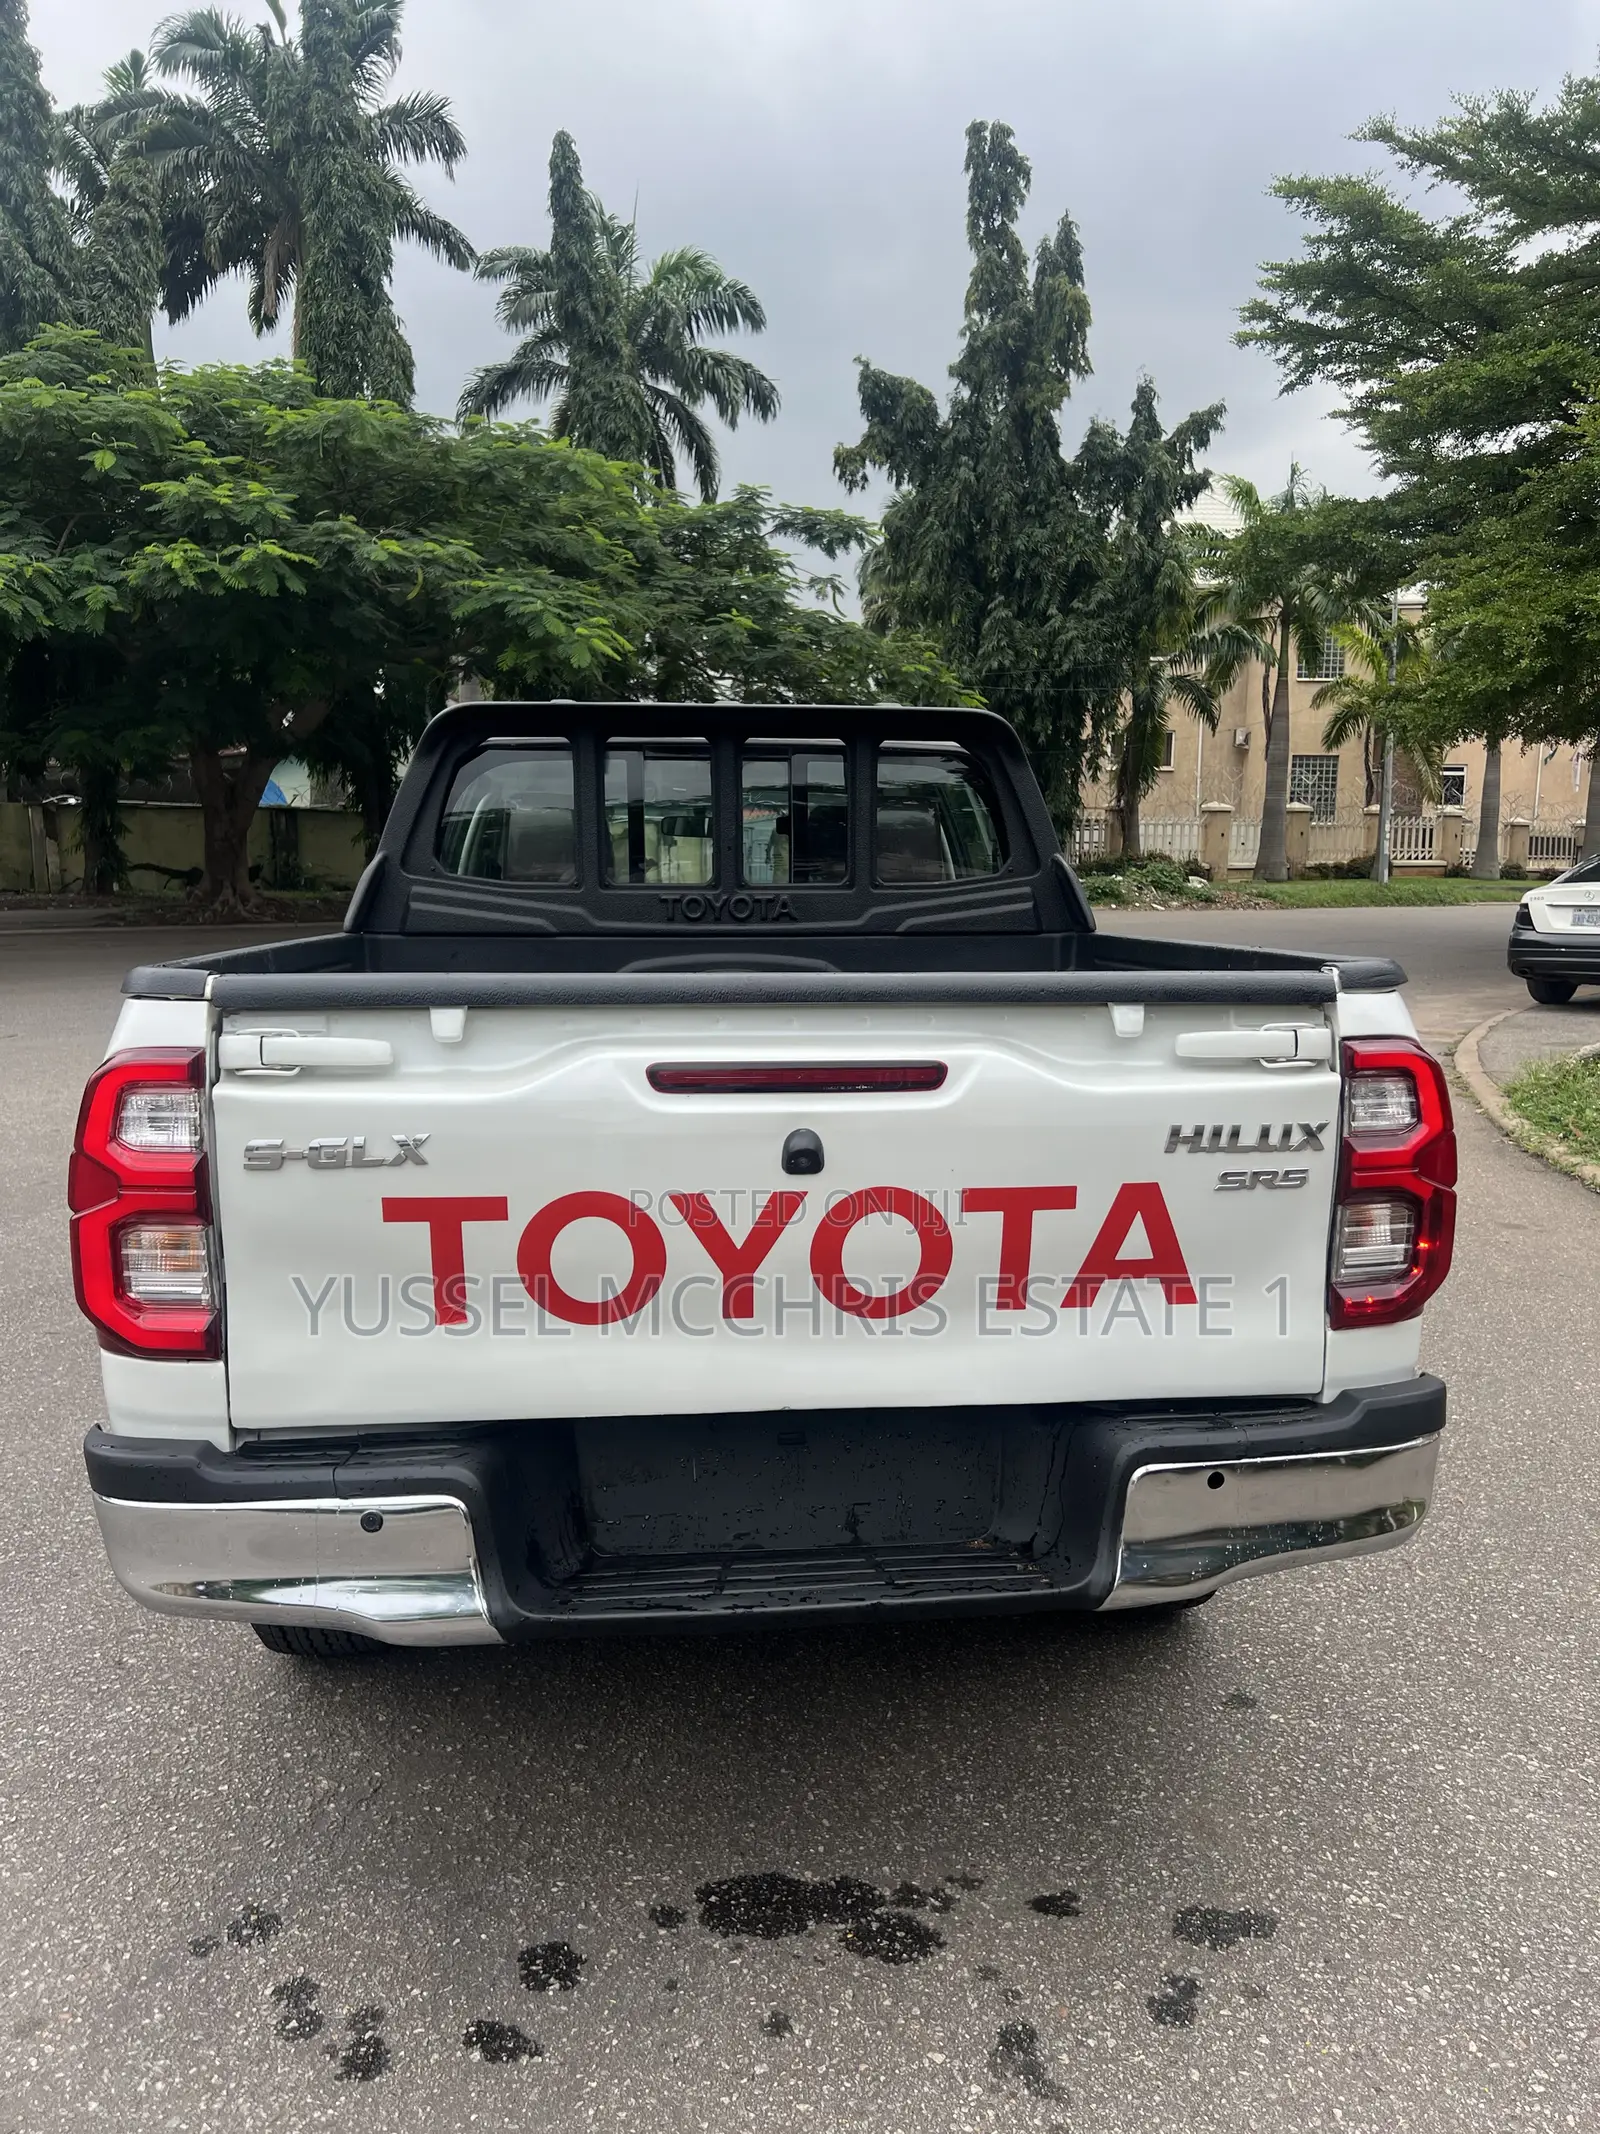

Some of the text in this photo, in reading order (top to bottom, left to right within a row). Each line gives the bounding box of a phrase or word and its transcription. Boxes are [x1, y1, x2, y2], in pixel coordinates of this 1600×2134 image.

[660, 893, 797, 921] TOYOTA
[243, 1133, 431, 1171] S-GLX
[1164, 1120, 1330, 1154] HILUX
[1214, 1168, 1308, 1191] SR5
[381, 1182, 1199, 1326] TOYOTA
